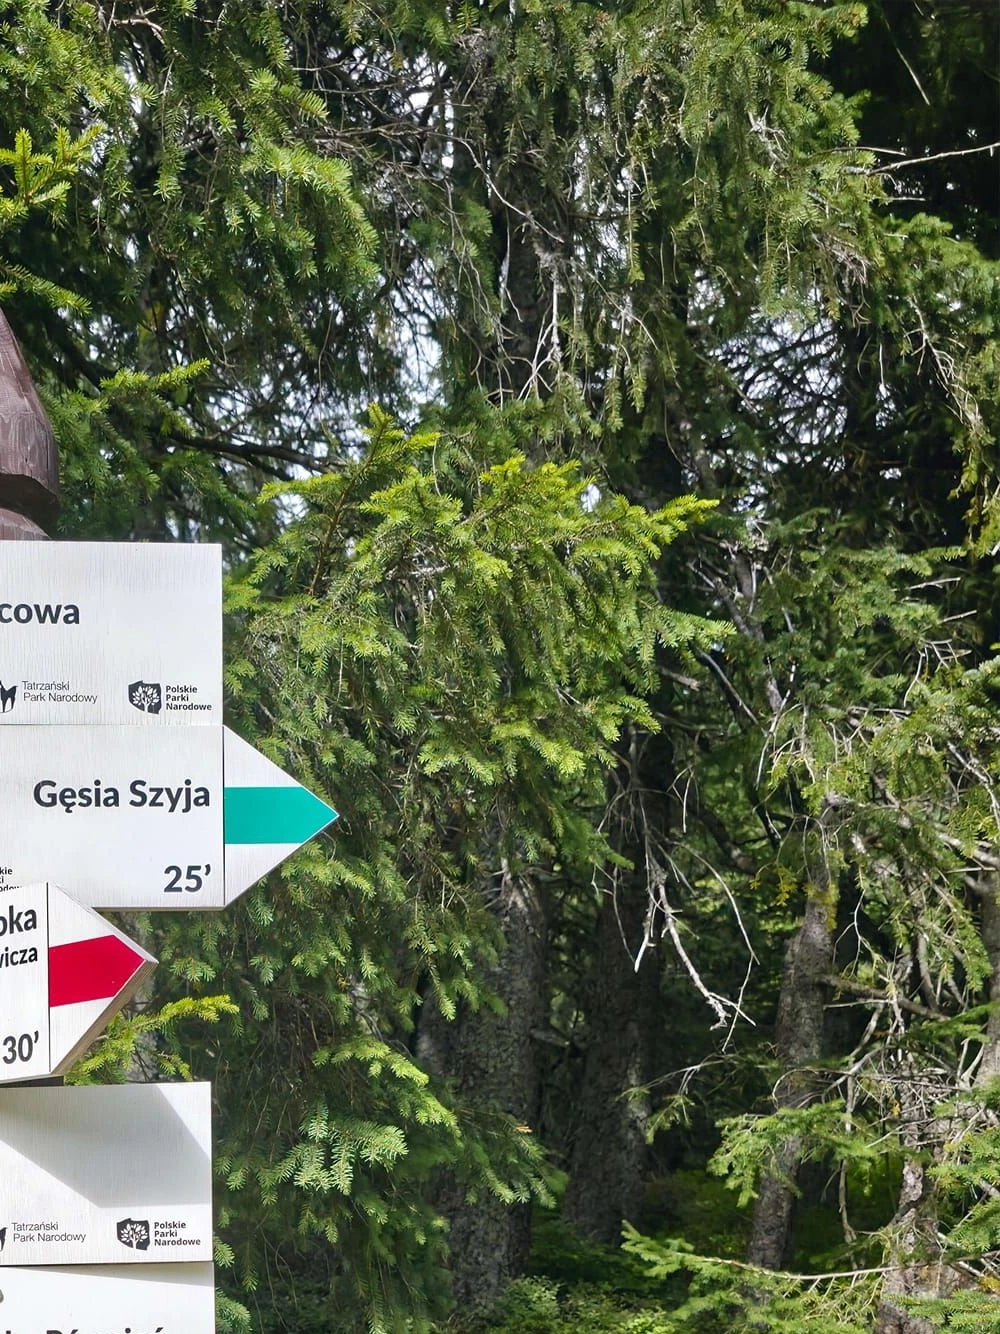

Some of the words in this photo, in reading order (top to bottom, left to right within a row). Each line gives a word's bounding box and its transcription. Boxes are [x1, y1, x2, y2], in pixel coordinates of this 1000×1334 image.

[22, 680, 71, 691] Tatrzański
[165, 685, 198, 694] Polskie
[23, 692, 46, 702] Park
[48, 692, 98, 705] Narodowy
[165, 694, 190, 702] Parki
[165, 702, 213, 711] Narodowe
[33, 780, 120, 813] Gęsia
[129, 780, 210, 813] Szyja
[12, 1221, 59, 1232] Tatrzański
[154, 1221, 187, 1230] Polskie
[13, 1232, 35, 1242] Park
[37, 1231, 87, 1244] Narodowy
[154, 1230, 178, 1238] Parki
[154, 1237, 201, 1247] Narodowe
